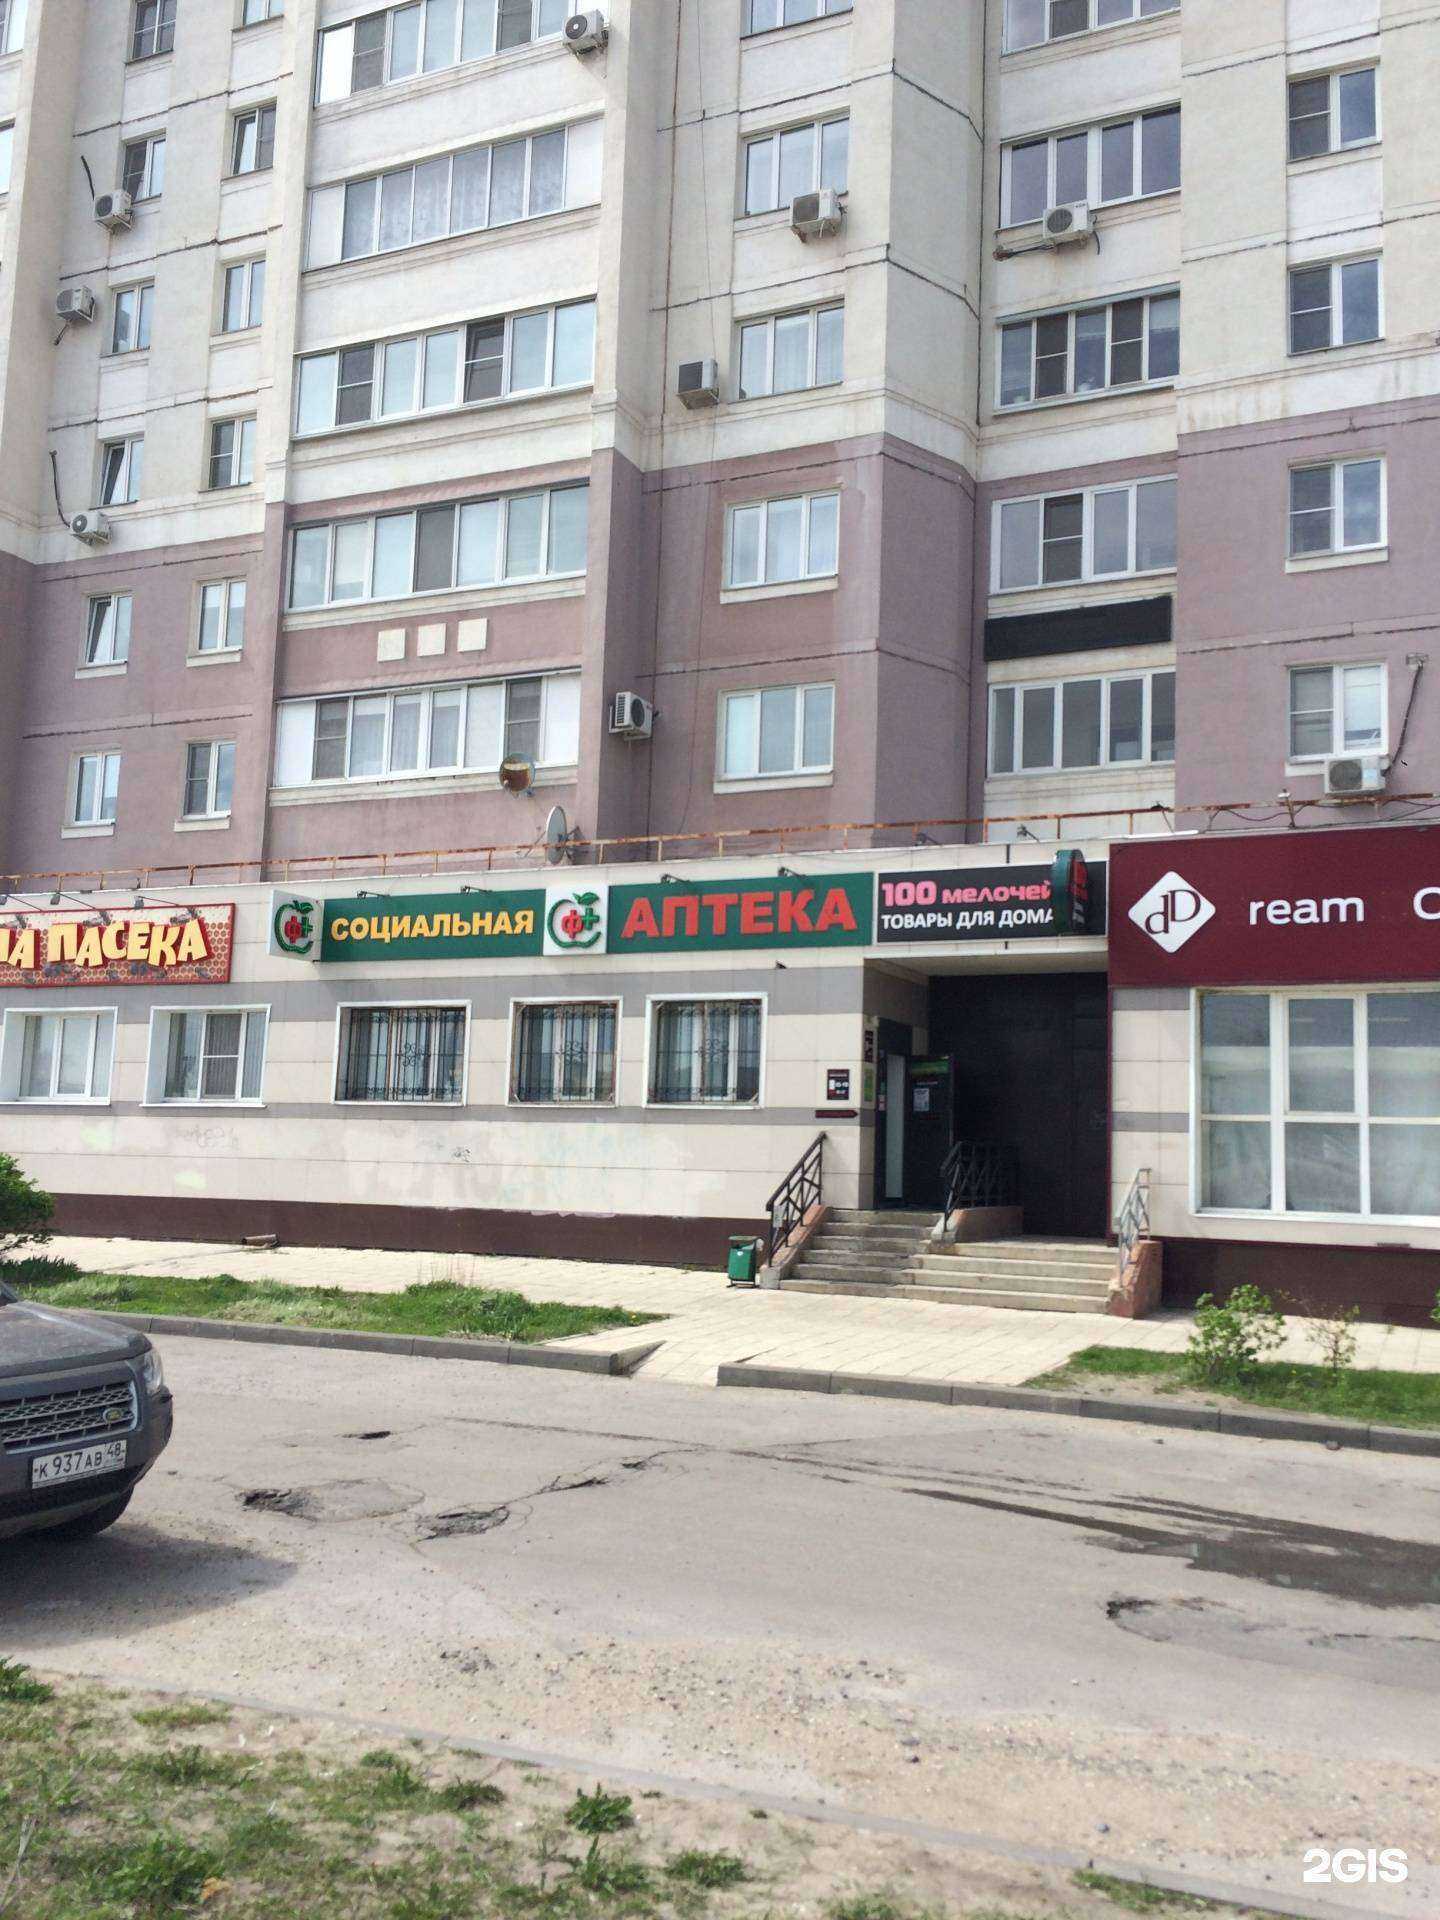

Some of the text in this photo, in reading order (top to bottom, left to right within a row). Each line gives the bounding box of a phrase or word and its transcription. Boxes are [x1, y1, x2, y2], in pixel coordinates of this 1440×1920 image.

[881, 880, 937, 907] 100
[330, 910, 535, 943] СОЦИАЛЬНАЯ
[620, 888, 858, 939] АПТЕКА
[881, 911, 953, 930] ТОВАРЫ
[955, 909, 995, 931] ДЛЯ
[1249, 896, 1365, 926] ream
[48, 918, 208, 968] ПАСЕКА
